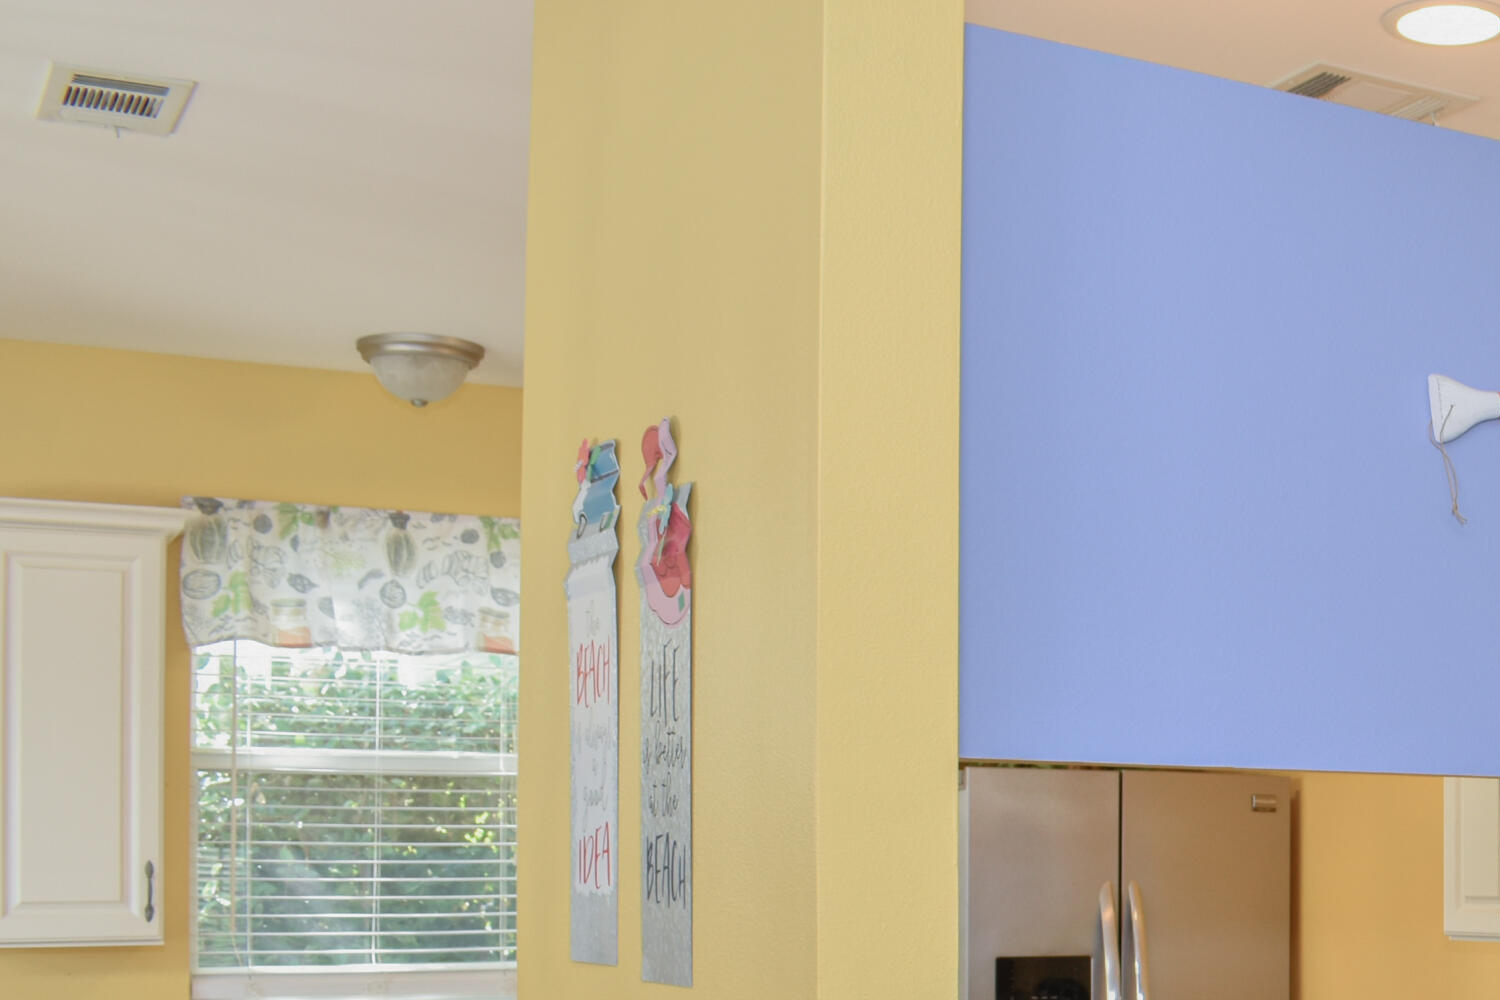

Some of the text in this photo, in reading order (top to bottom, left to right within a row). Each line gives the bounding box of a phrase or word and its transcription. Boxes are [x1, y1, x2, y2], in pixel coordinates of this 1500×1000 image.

[576, 634, 611, 709] BEACH
[650, 638, 681, 728] LIFE
[655, 719, 688, 770] better
[578, 821, 612, 890] IDEA
[646, 831, 687, 911] BEACH
